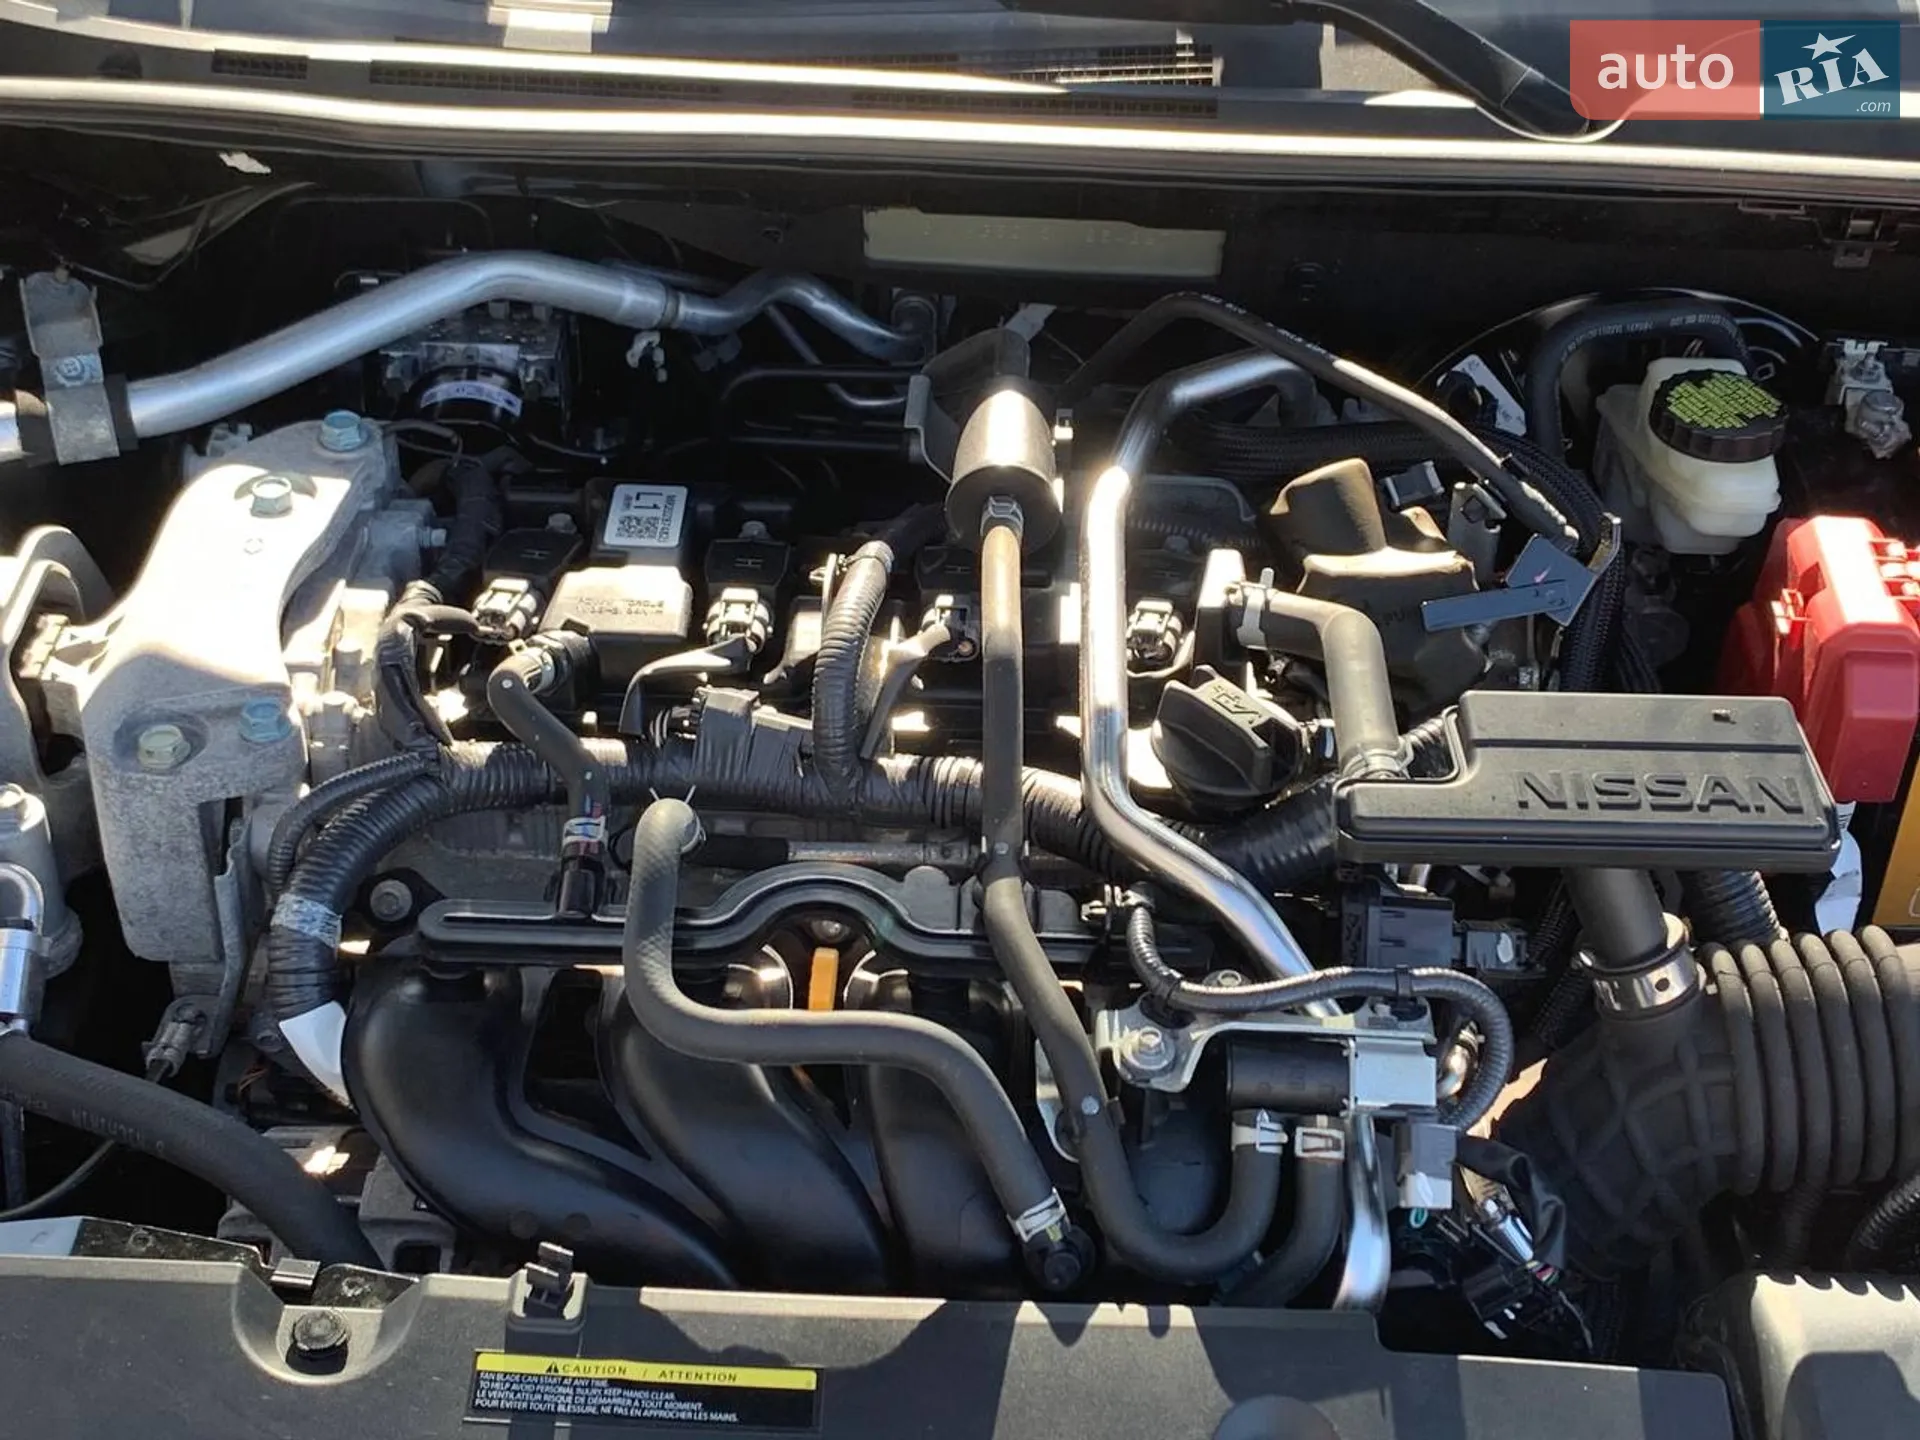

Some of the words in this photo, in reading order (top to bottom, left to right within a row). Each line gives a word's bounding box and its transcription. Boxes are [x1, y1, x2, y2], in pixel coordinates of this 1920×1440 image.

[1514, 770, 1804, 814] NISSAN
[480, 1371, 495, 1380] FAN
[496, 1373, 520, 1382] BLADE
[521, 1374, 538, 1384] CAN
[540, 1375, 561, 1385] START
[562, 1377, 573, 1385] AT
[572, 1378, 590, 1386] ANY
[562, 1363, 627, 1376] CAUTION
[658, 1370, 737, 1383] ATTENTION
[477, 1389, 487, 1398] LE
[488, 1390, 542, 1401] VENTILATEUR
[543, 1393, 572, 1404] RISQUE
[574, 1395, 585, 1404] DE
[641, 1399, 663, 1409] TOUT
[480, 1379, 490, 1389] TO
[491, 1381, 511, 1390] HELP
[510, 1383, 535, 1392] AVOID
[536, 1384, 574, 1395] PERSONAL
[603, 1387, 622, 1397] KEEP
[622, 1389, 649, 1399] HANDS
[475, 1398, 499, 1408] POUR
[529, 1402, 555, 1412] TOUTE
[600, 1406, 612, 1415] NE
[613, 1406, 629, 1416] PAS
[630, 1407, 642, 1417] EN
[642, 1408, 692, 1420] APPROCHER
[693, 1411, 708, 1421] LES
